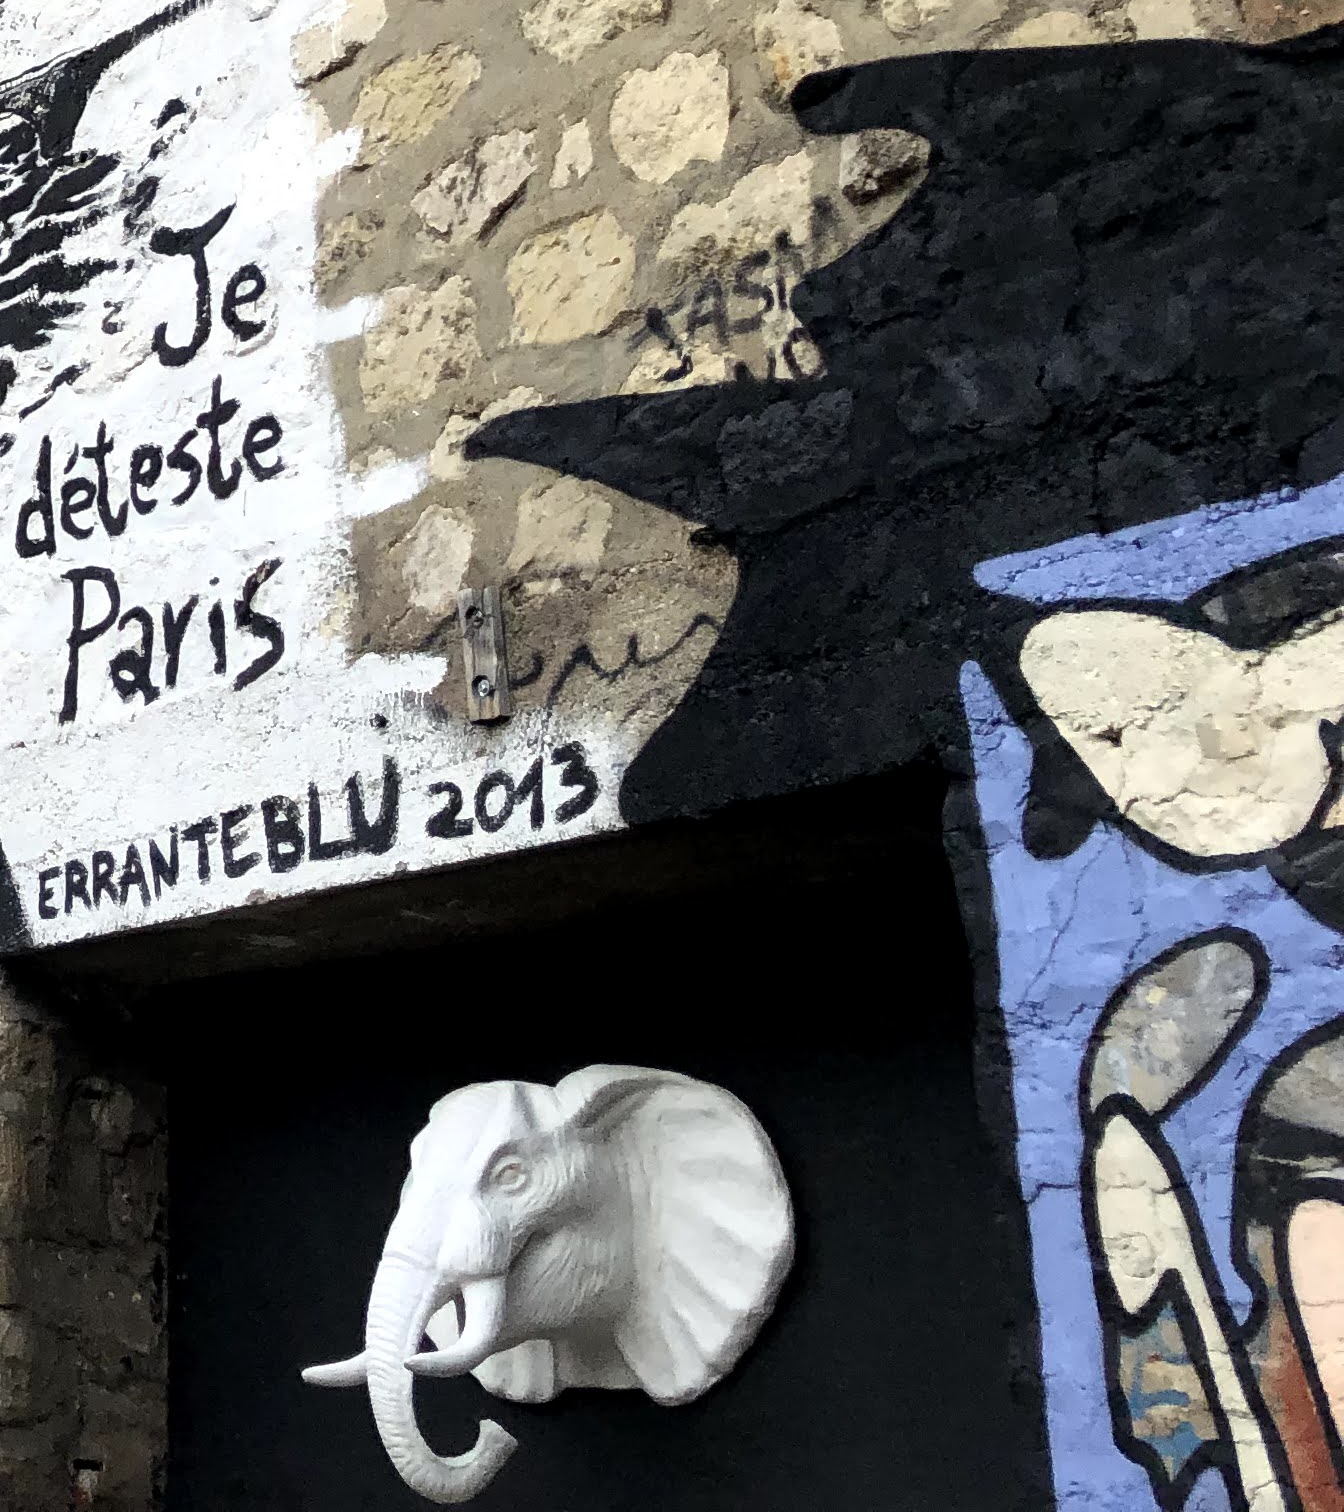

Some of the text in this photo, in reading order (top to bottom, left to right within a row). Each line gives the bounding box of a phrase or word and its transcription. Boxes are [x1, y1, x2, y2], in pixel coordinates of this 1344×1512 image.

[150, 203, 268, 367] Je
[14, 374, 284, 558] déteste
[57, 557, 286, 724] Paris
[36, 740, 600, 920] ERRANTEBLU 2013
